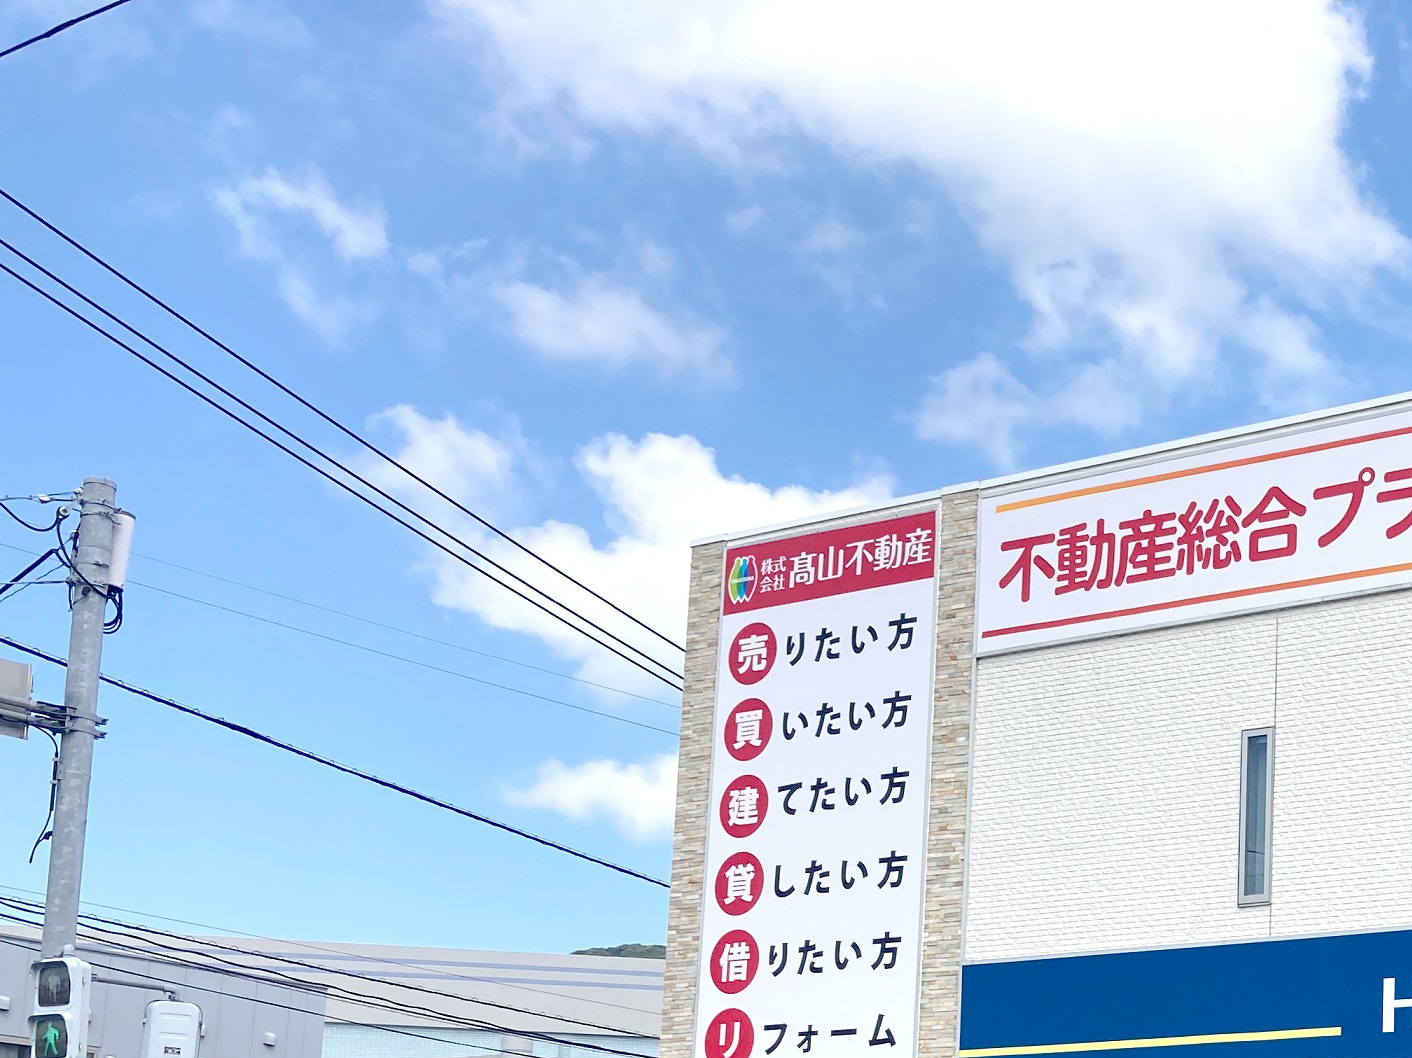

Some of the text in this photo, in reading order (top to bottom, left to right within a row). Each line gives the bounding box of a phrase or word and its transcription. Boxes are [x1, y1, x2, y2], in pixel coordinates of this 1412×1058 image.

[735, 612, 917, 677] 売りたい方
[730, 690, 912, 754] 買いたい方
[726, 766, 910, 830] 建てたい方
[721, 850, 908, 907] 貸したい方
[717, 931, 902, 986] 借りたい方
[711, 1013, 897, 1058] リフォーム
